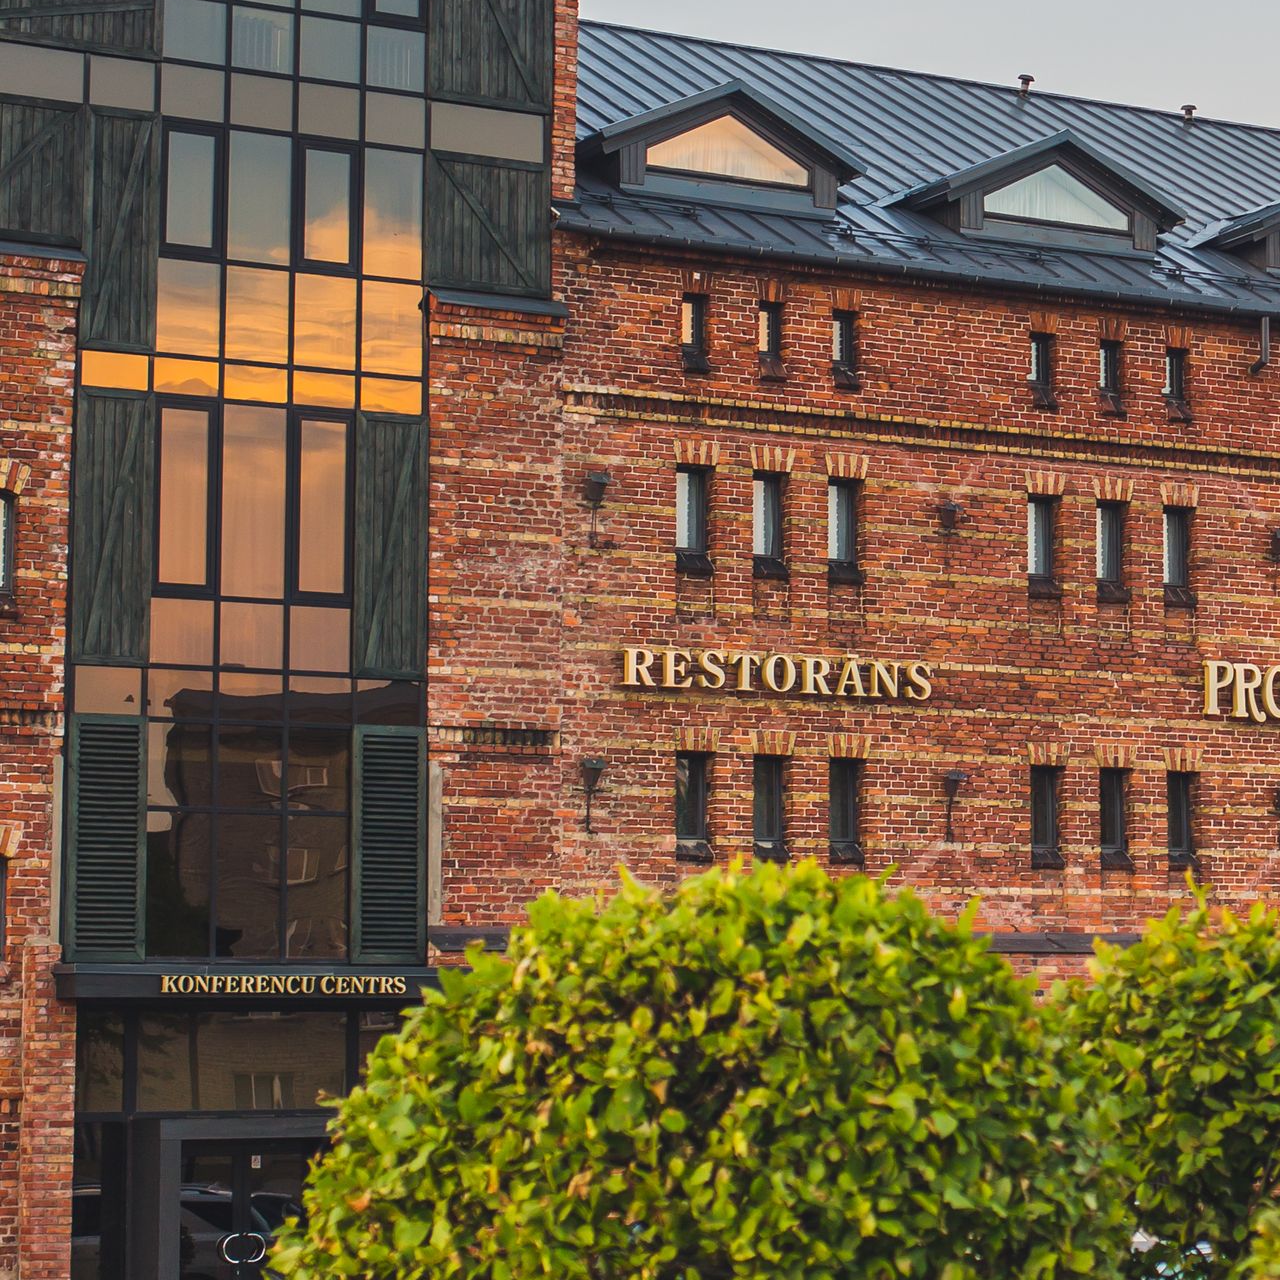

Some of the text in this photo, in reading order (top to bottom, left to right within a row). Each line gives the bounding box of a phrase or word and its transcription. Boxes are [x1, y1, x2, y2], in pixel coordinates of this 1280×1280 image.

[621, 647, 934, 701] RESTORĀNS
[160, 975, 407, 995] KONFERENCU CENTRS
